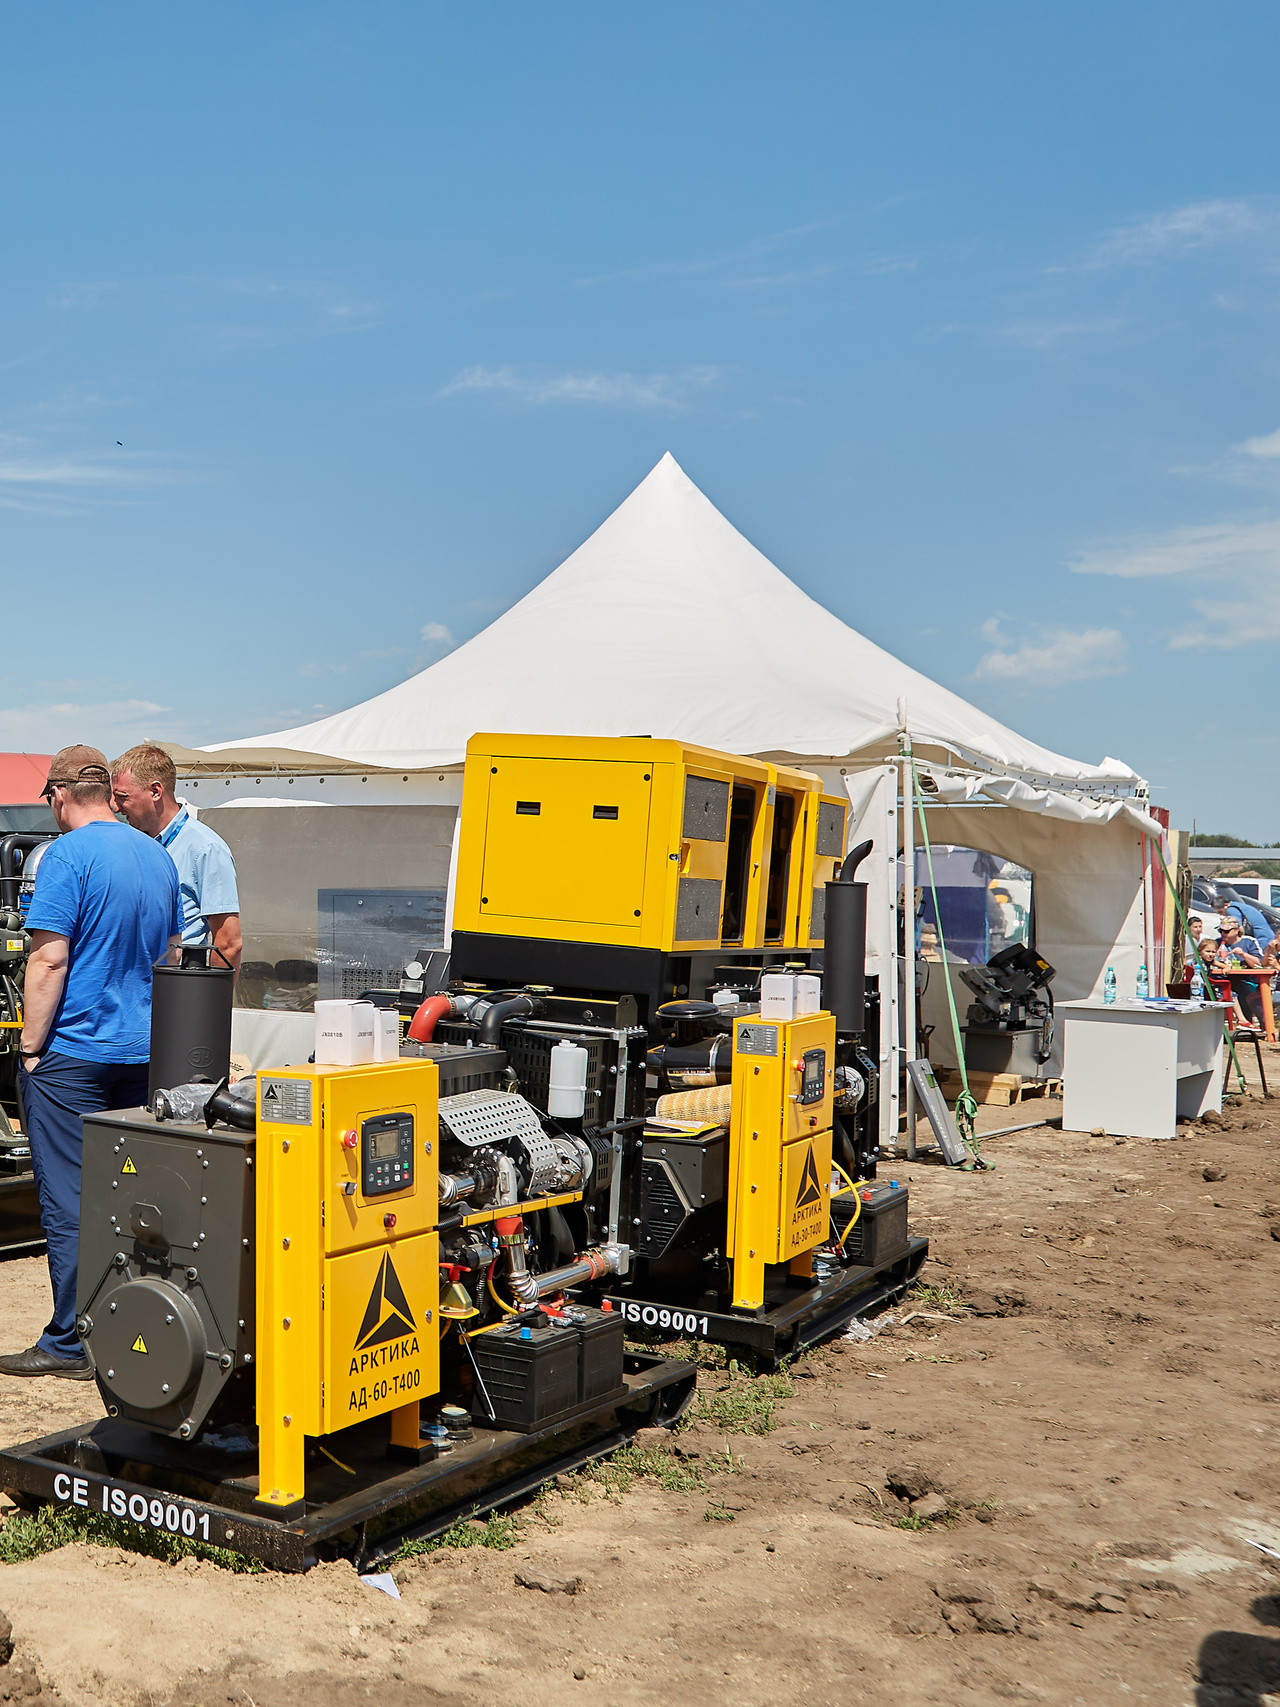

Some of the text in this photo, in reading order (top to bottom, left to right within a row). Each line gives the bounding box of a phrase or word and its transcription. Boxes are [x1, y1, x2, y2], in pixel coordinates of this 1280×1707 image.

[792, 1201, 823, 1226] АРКТИКА
[620, 1301, 709, 1335] ISO9001
[348, 1337, 420, 1377] АРКТИКА
[53, 1473, 210, 1541] CE ISO9001
